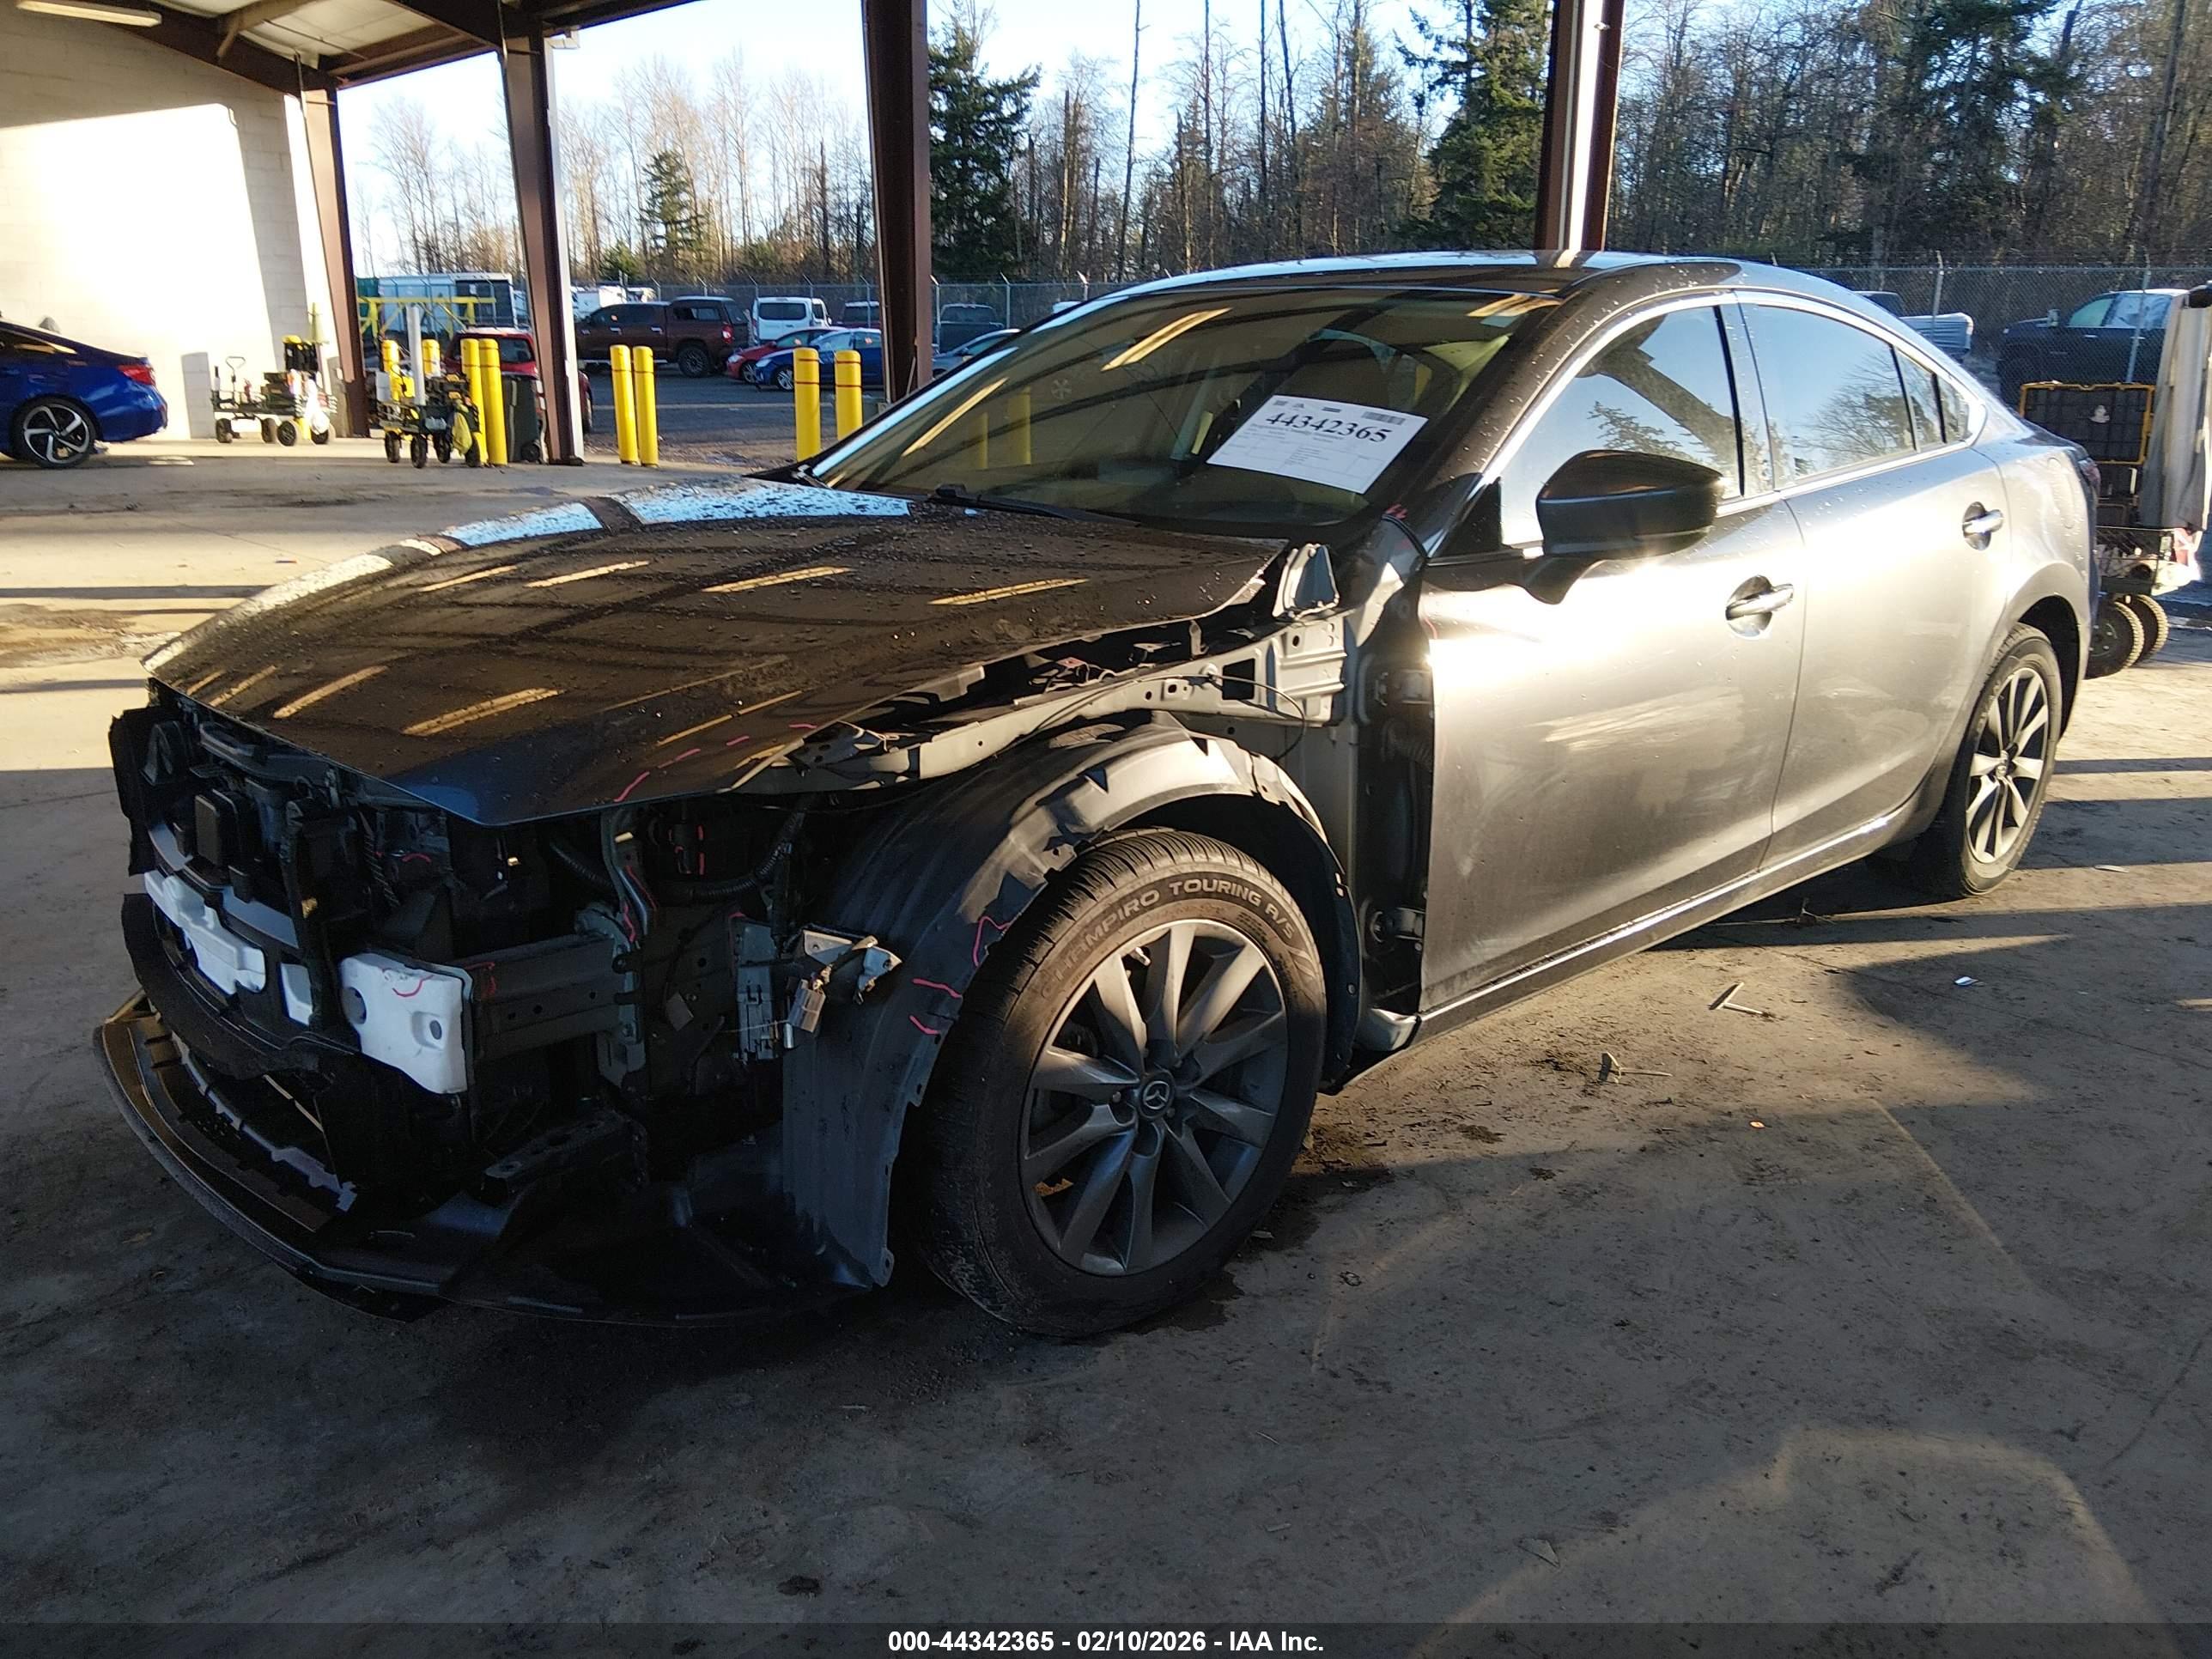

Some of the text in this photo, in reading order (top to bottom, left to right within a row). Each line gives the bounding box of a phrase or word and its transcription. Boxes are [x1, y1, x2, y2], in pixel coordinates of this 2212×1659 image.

[1267, 412, 1392, 442] 44342365
[1169, 878, 1262, 907] TOURING
[1265, 902, 1295, 939] A/S
